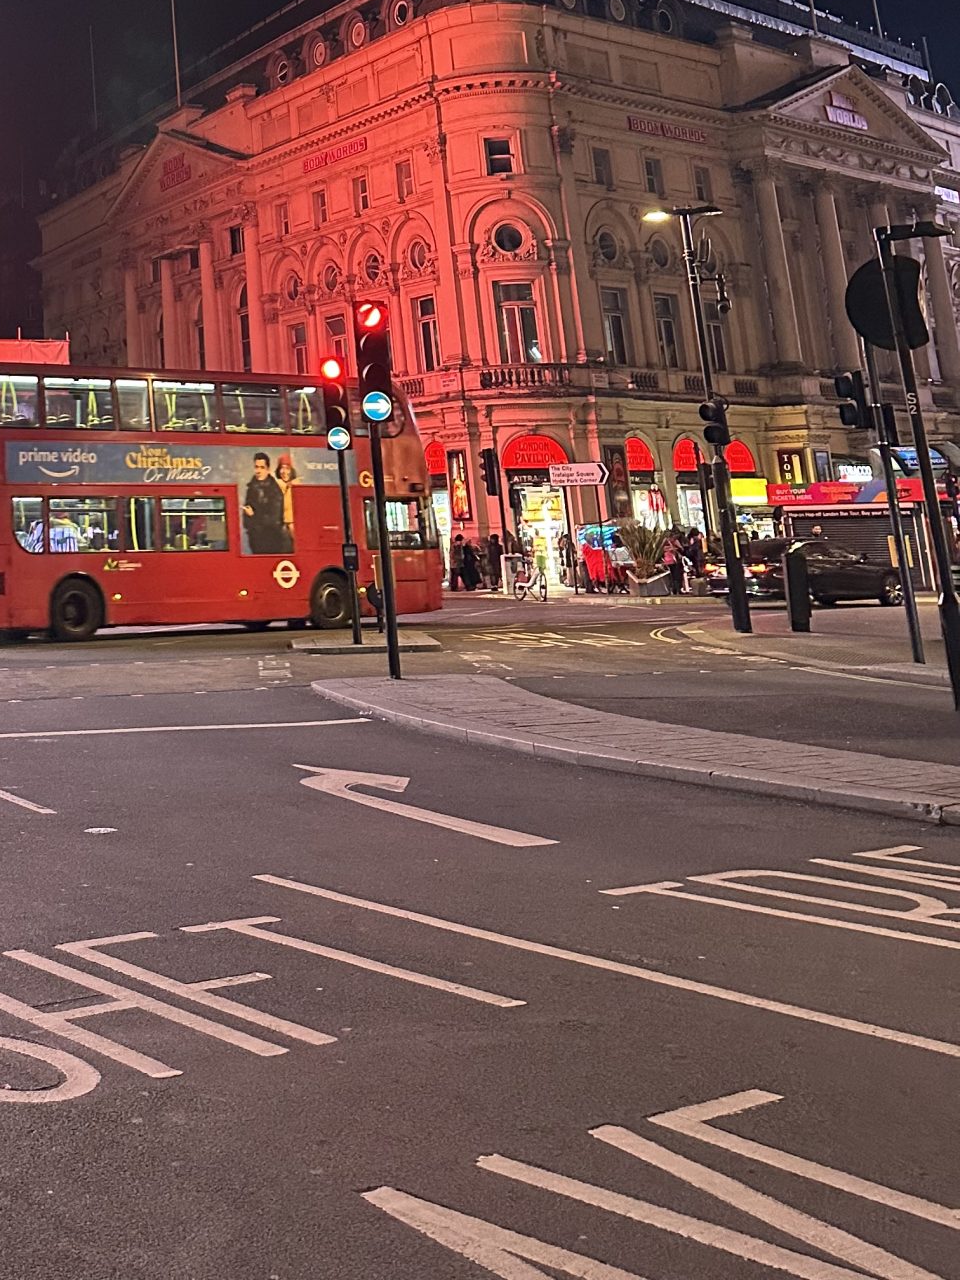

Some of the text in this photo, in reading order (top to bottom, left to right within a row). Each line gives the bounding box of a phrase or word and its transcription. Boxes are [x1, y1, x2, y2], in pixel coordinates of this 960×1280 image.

[663, 124, 707, 141] WORLDS
[304, 138, 365, 172] BODY WORLDS
[518, 441, 550, 451] LONDON
[19, 448, 97, 465] prime video
[515, 452, 556, 464] PAVILION
[789, 487, 806, 495] YOUR
